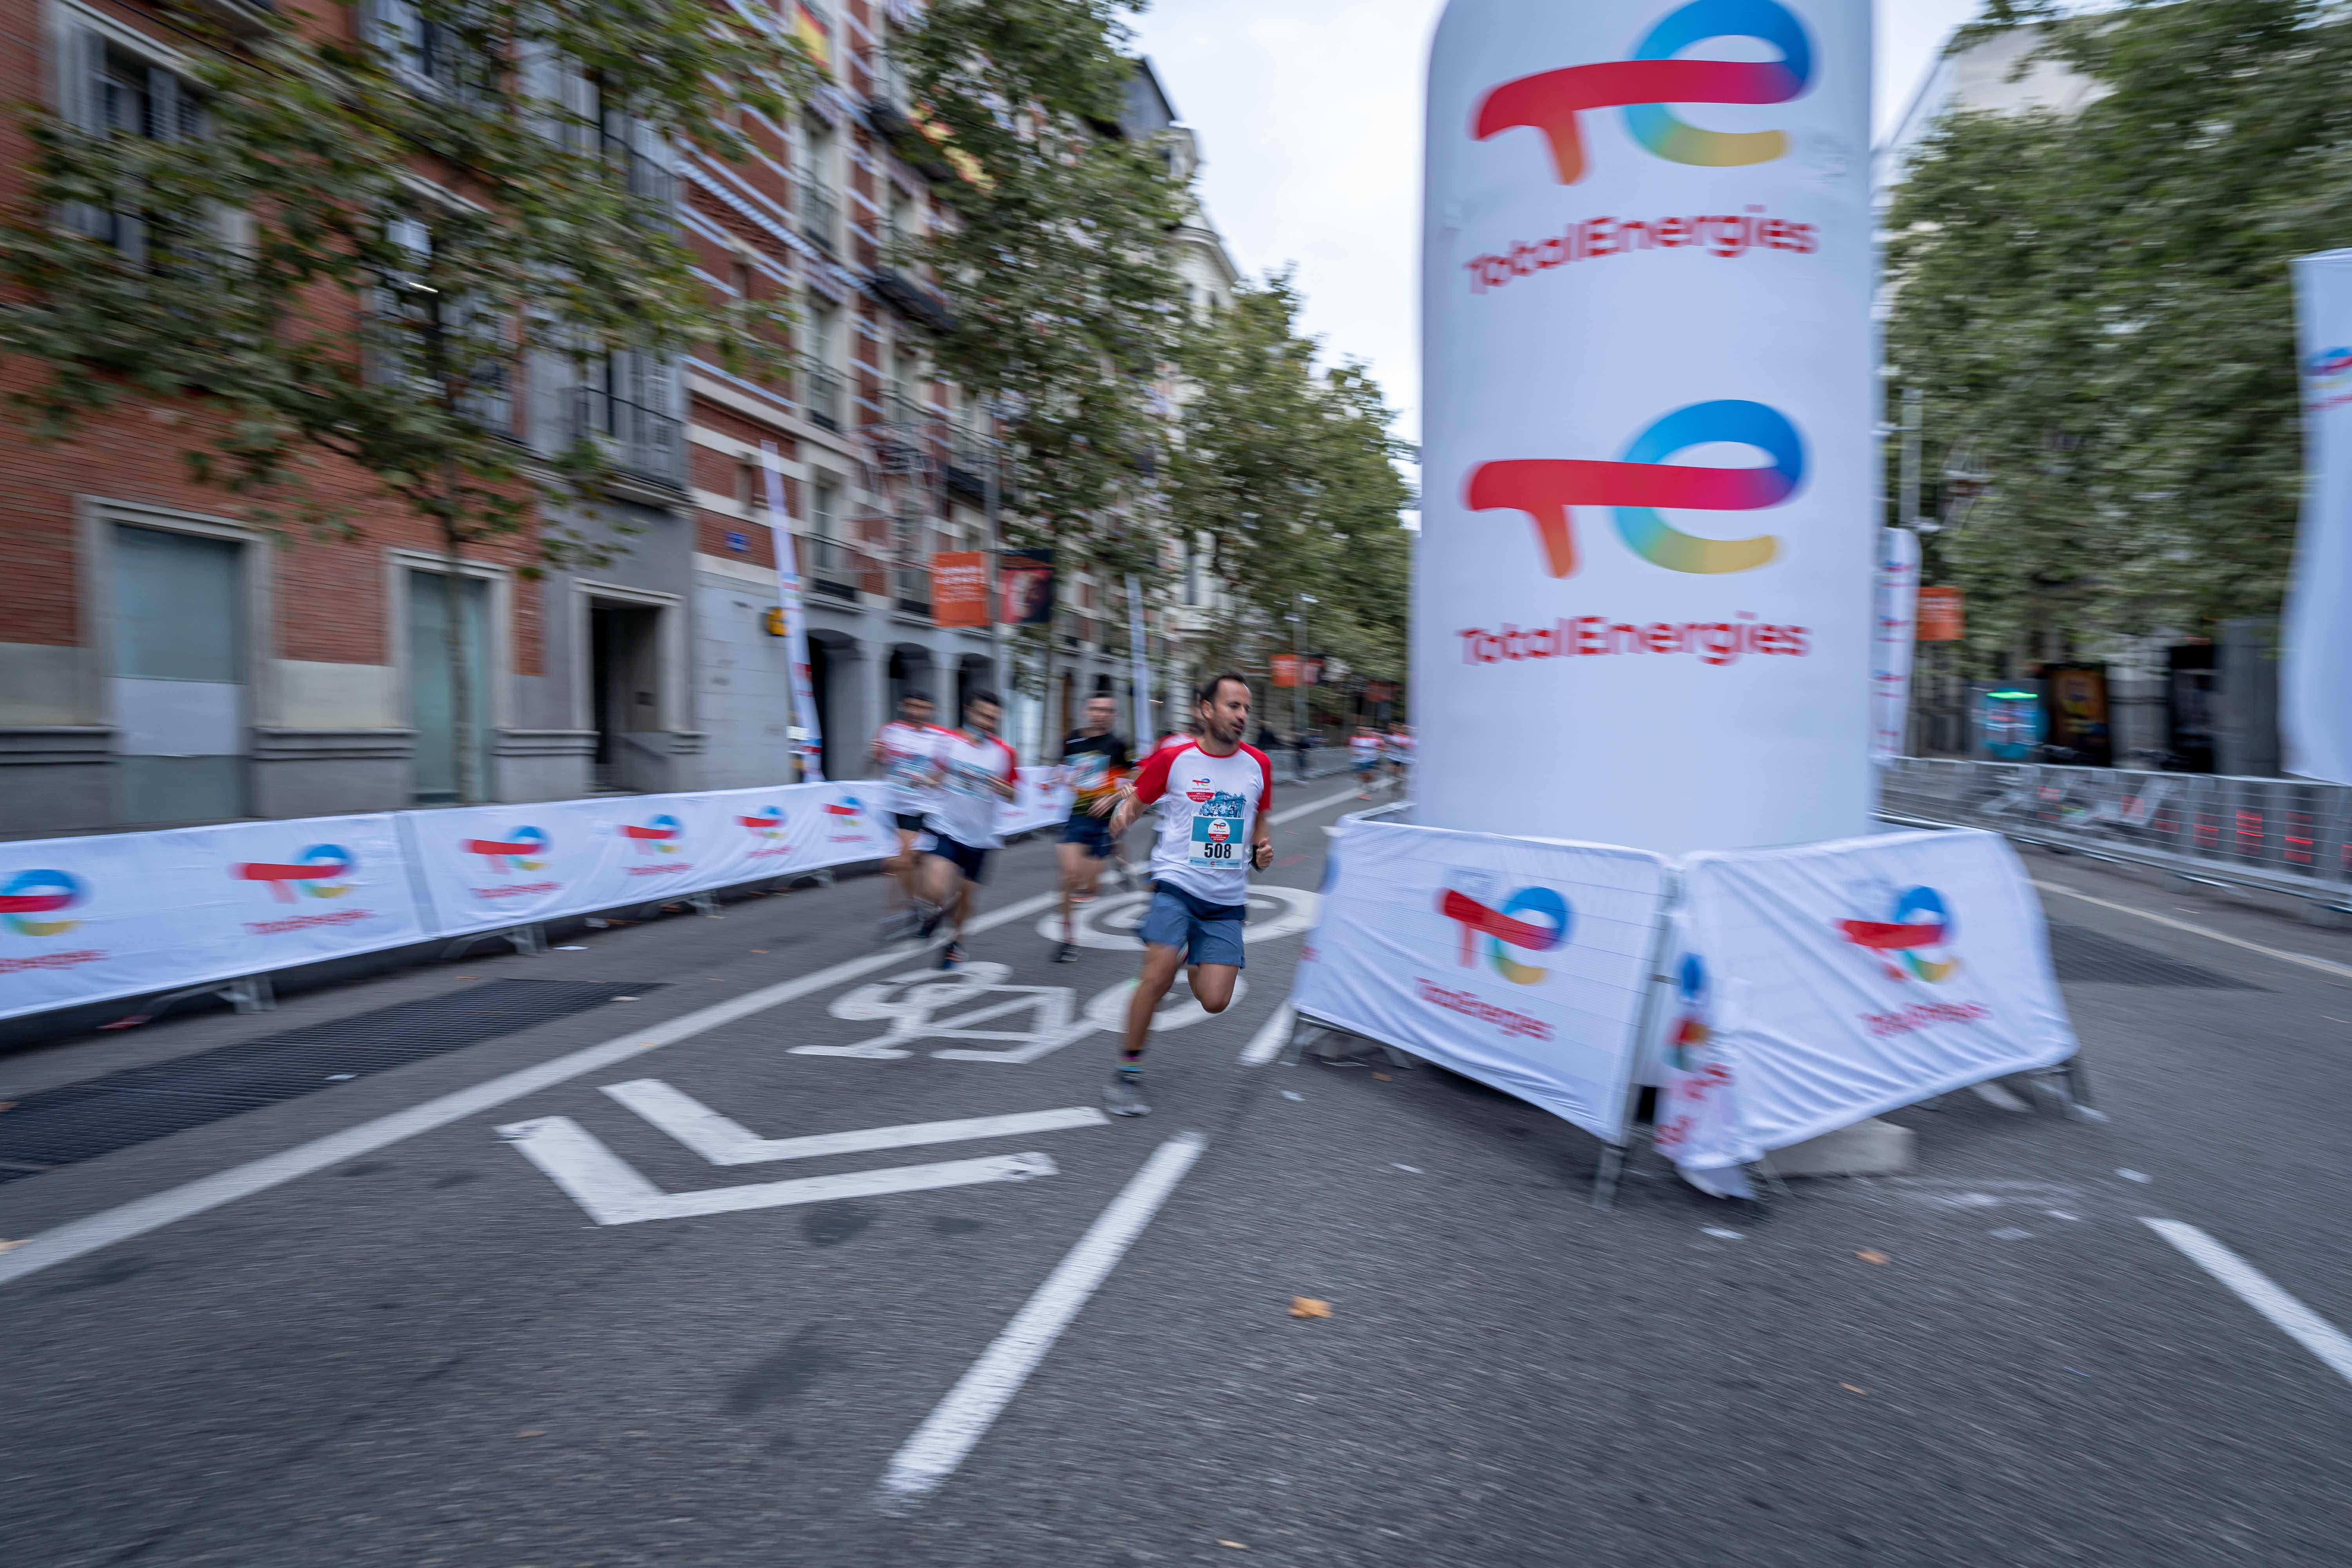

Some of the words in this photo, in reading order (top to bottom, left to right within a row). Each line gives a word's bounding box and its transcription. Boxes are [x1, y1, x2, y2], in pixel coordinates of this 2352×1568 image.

[1463, 205, 1819, 294] TotalEnergies
[1456, 610, 1813, 666] TotalEnergies
[1204, 843, 1231, 858] 508
